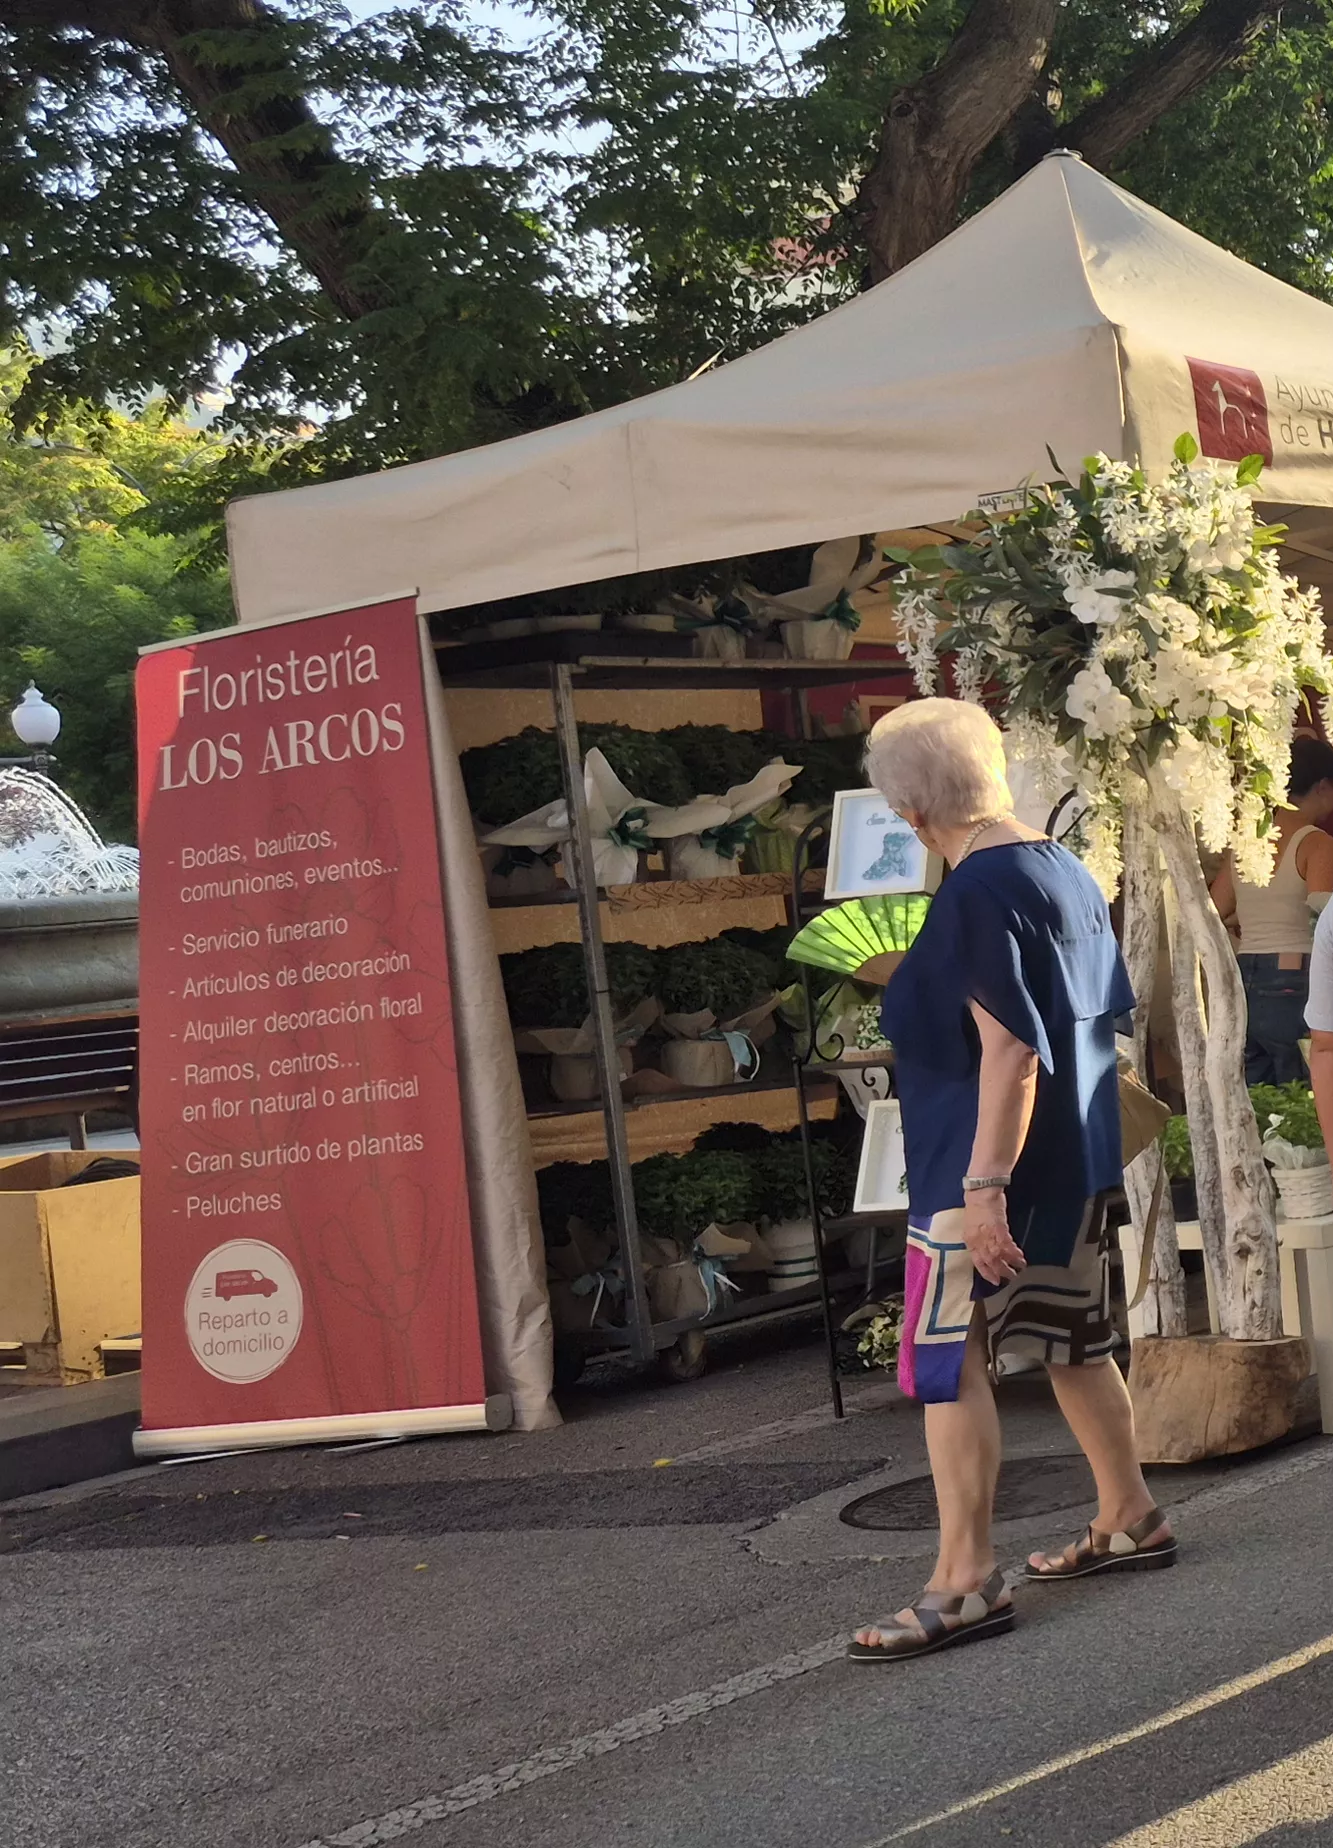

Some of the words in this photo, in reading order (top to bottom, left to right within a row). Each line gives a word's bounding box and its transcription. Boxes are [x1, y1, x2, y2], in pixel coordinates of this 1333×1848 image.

[1281, 416, 1309, 447] de
[178, 635, 379, 718] Floristería
[159, 732, 243, 790] LOS
[258, 703, 405, 774] ARCOS
[182, 843, 247, 869] Bodas,
[255, 830, 338, 858] bautizos,
[180, 868, 298, 902] comuniones,
[305, 857, 398, 884] eventos...
[183, 927, 259, 955] Servicio
[266, 914, 348, 944] funerario
[183, 970, 270, 999] Artículos
[276, 965, 298, 987] de
[302, 951, 410, 983] decoración
[183, 1015, 257, 1044] Alquiler
[264, 1001, 373, 1033] decoración
[380, 992, 423, 1019] floral
[185, 1062, 261, 1086] Ramos,
[269, 1052, 360, 1077] centros...
[182, 1104, 206, 1123] en
[212, 1097, 242, 1119] flor
[250, 1088, 317, 1115] natural
[322, 1089, 334, 1107] o
[341, 1075, 419, 1105] artificial
[185, 1151, 233, 1174] Gran
[239, 1142, 311, 1168] surtido
[316, 1138, 341, 1161] de
[347, 1132, 424, 1161] plantas
[187, 1191, 282, 1219] Peluches
[198, 1309, 271, 1337] Reparto
[277, 1310, 288, 1326] a
[202, 1335, 285, 1359] domicilio
